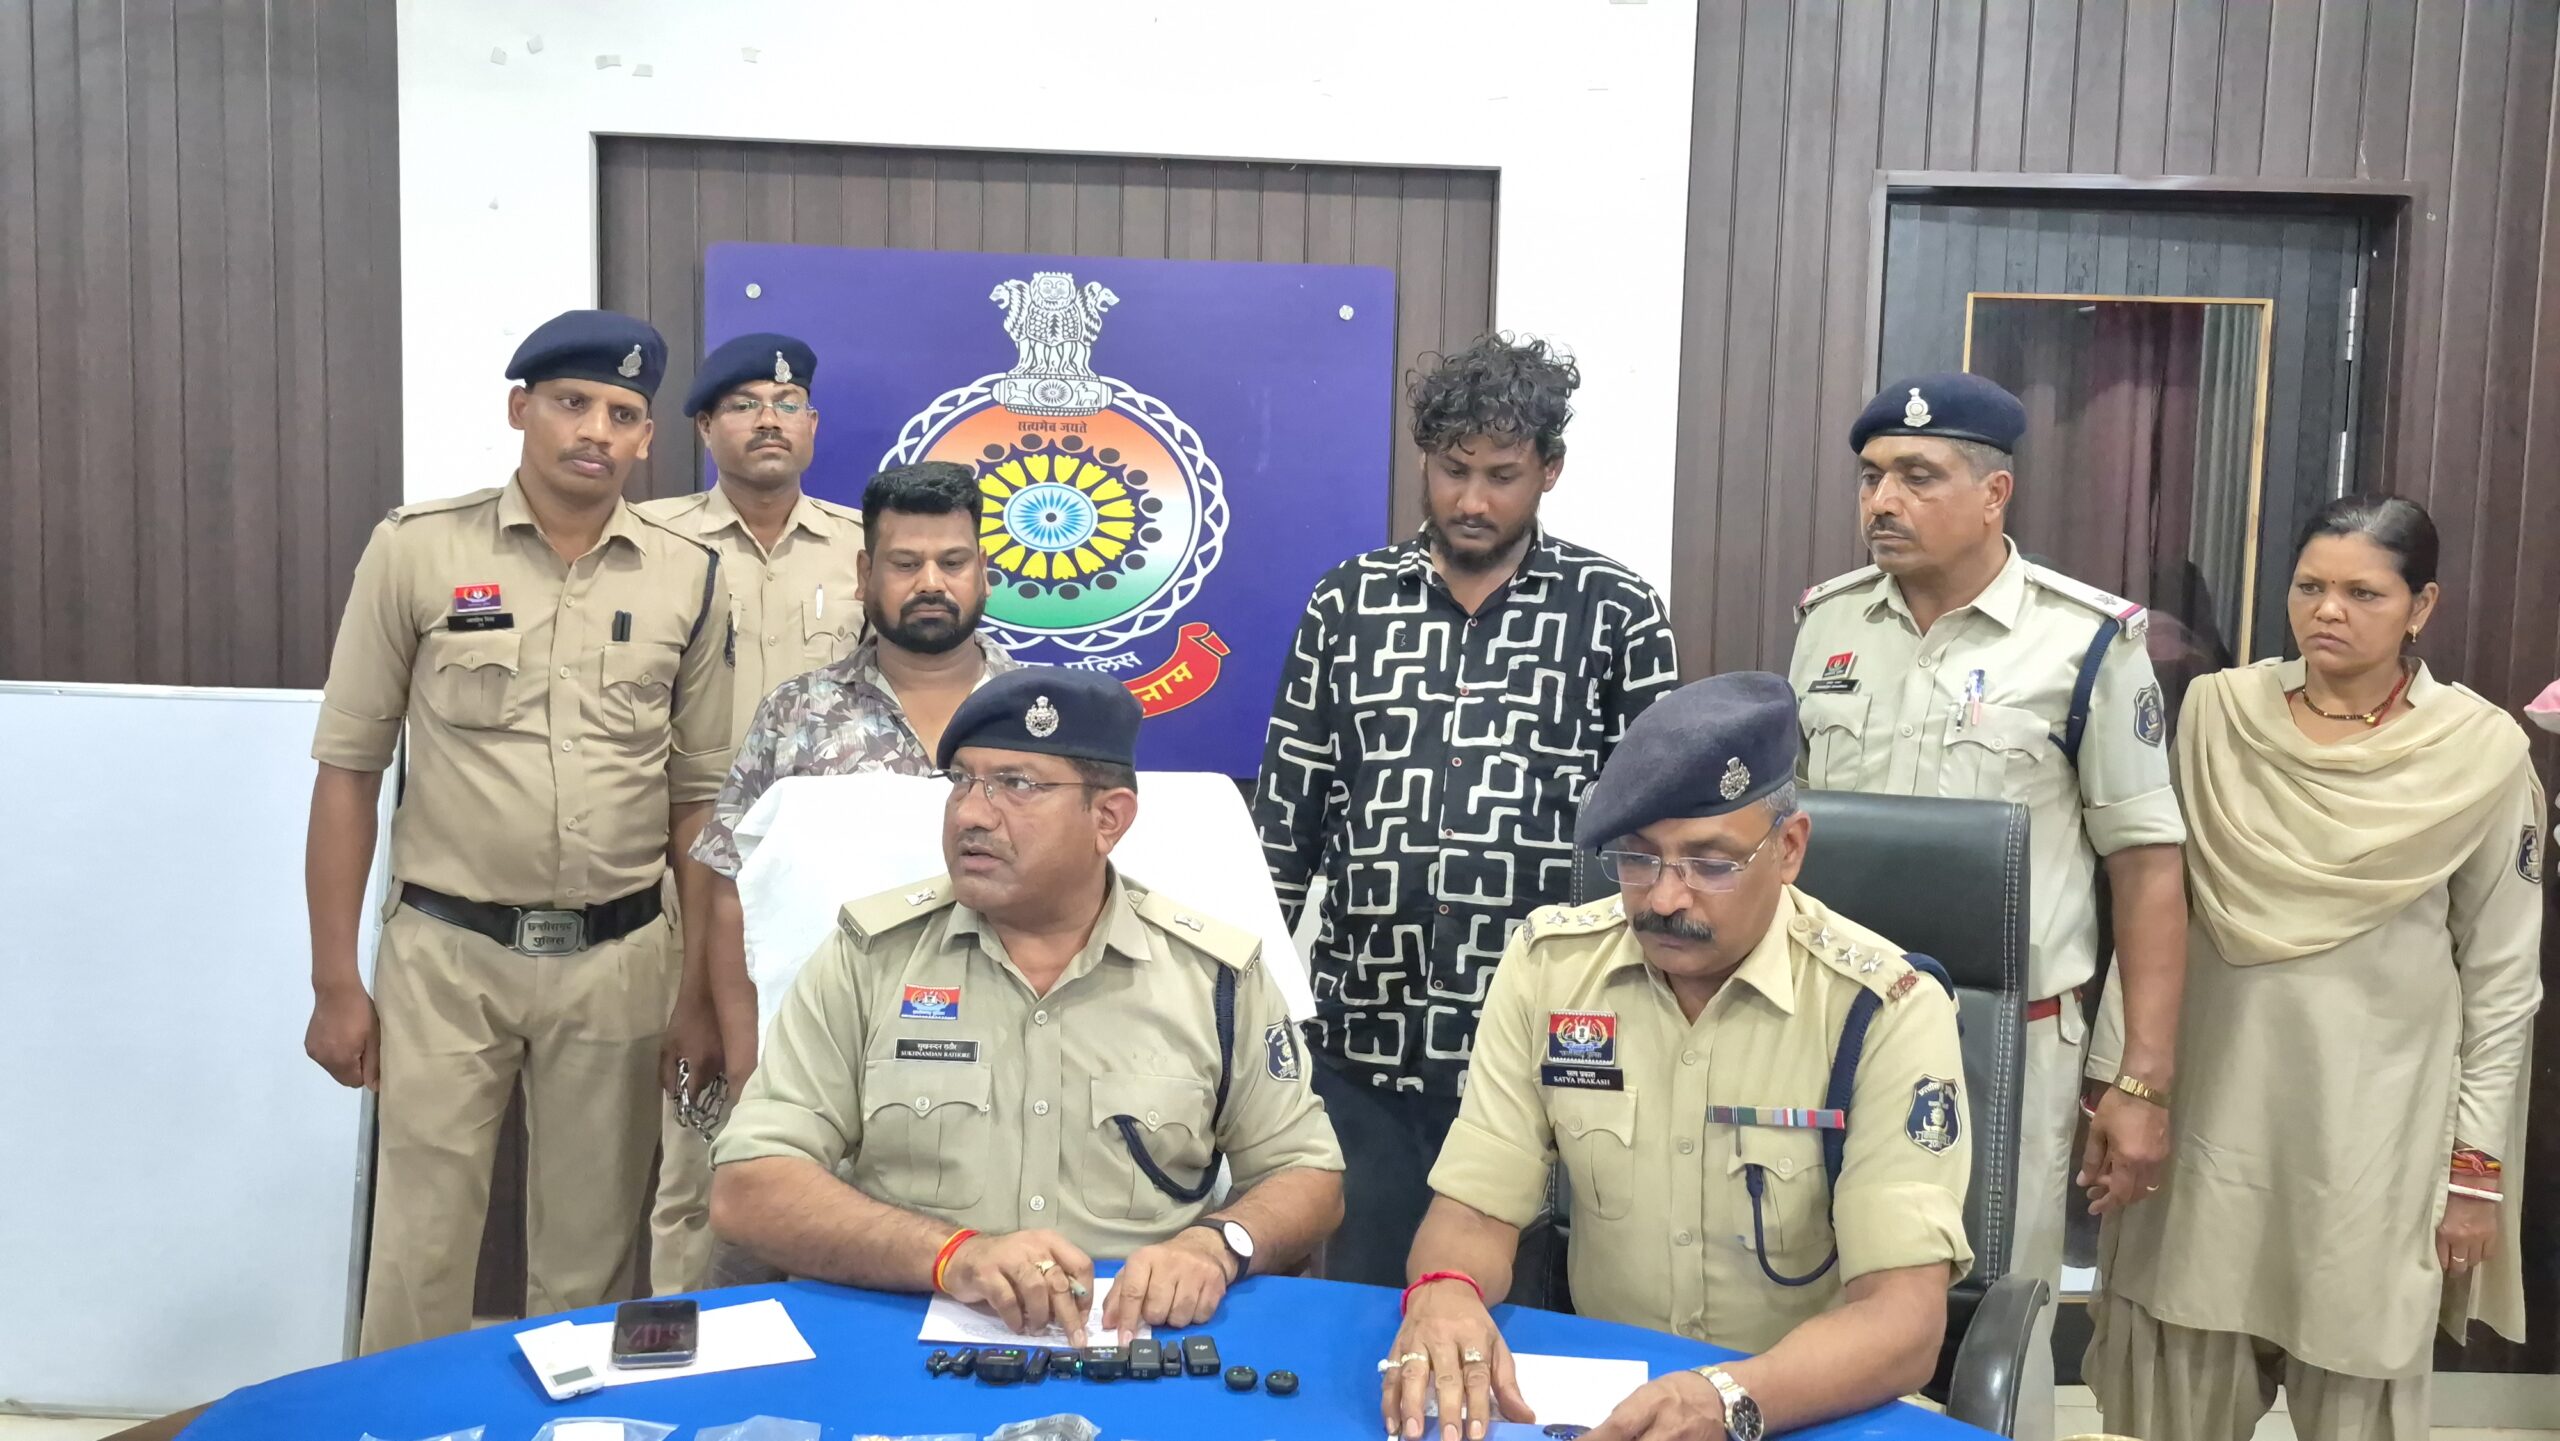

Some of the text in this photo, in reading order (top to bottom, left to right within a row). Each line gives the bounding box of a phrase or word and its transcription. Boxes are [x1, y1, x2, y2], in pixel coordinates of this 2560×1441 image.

[1018, 420, 1087, 433] सत्यमेव जयते
[533, 935, 566, 948] पुलिस
[1553, 1075, 1611, 1087] SATYA PRAKASH
